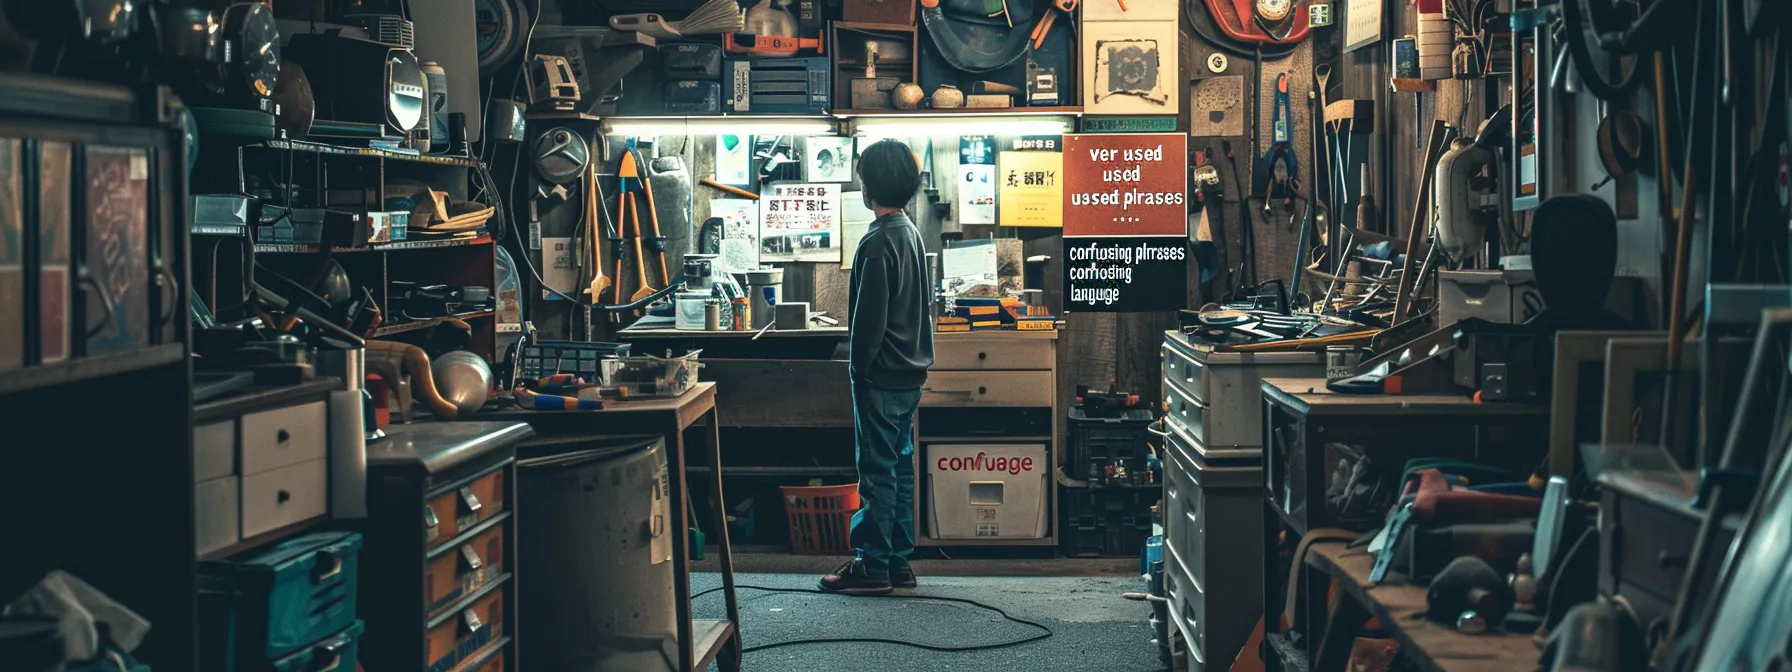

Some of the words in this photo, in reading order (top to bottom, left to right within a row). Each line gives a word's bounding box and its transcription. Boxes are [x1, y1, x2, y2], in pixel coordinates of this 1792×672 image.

[1089, 148, 1118, 161] ver
[1123, 144, 1163, 162] used
[1103, 164, 1141, 182] used
